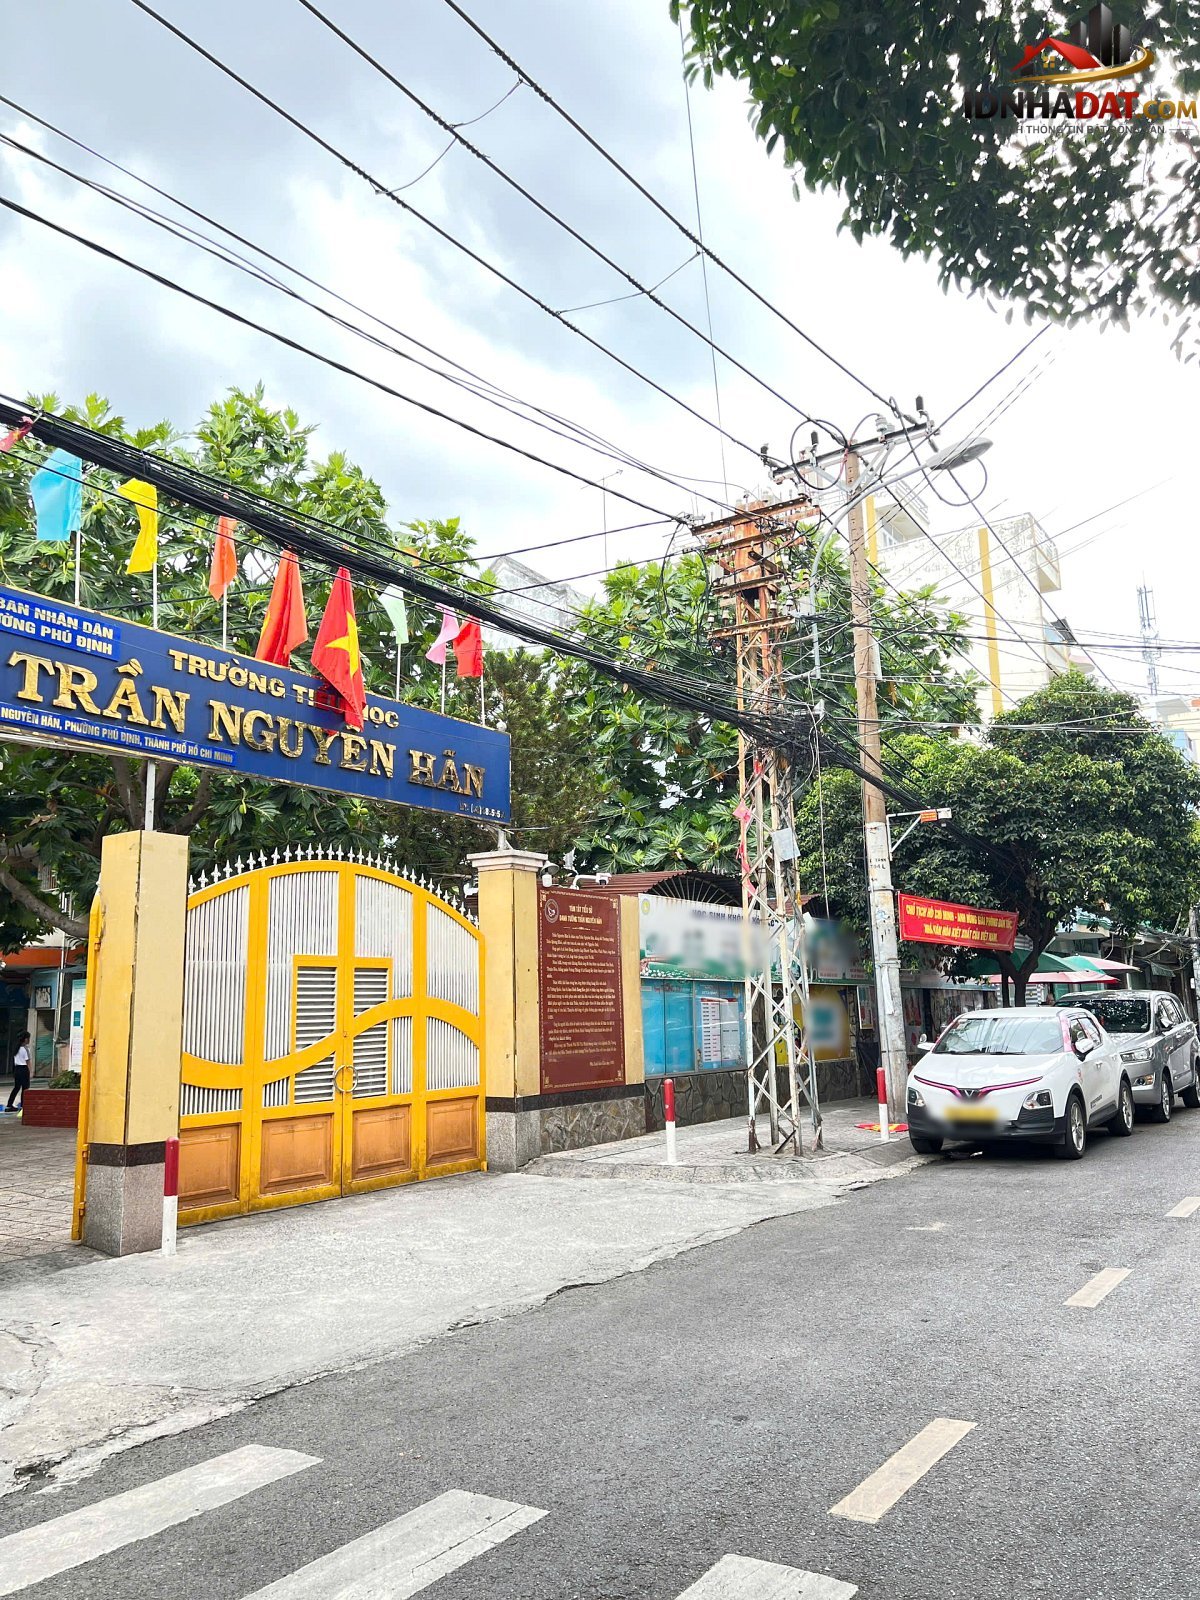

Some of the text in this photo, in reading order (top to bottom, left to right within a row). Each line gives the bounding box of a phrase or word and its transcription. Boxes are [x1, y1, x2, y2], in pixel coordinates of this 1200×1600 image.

[0, 612, 113, 655] ỜNG PHÚ ĐỊNH
[34, 608, 79, 630] NHÂN
[82, 621, 114, 640] DÂN
[8, 650, 191, 734] TRẦN
[168, 648, 286, 699] TRƯỜNG
[101, 727, 119, 740] PHÚ
[144, 736, 170, 751] THÀNH
[213, 751, 233, 763] MINH
